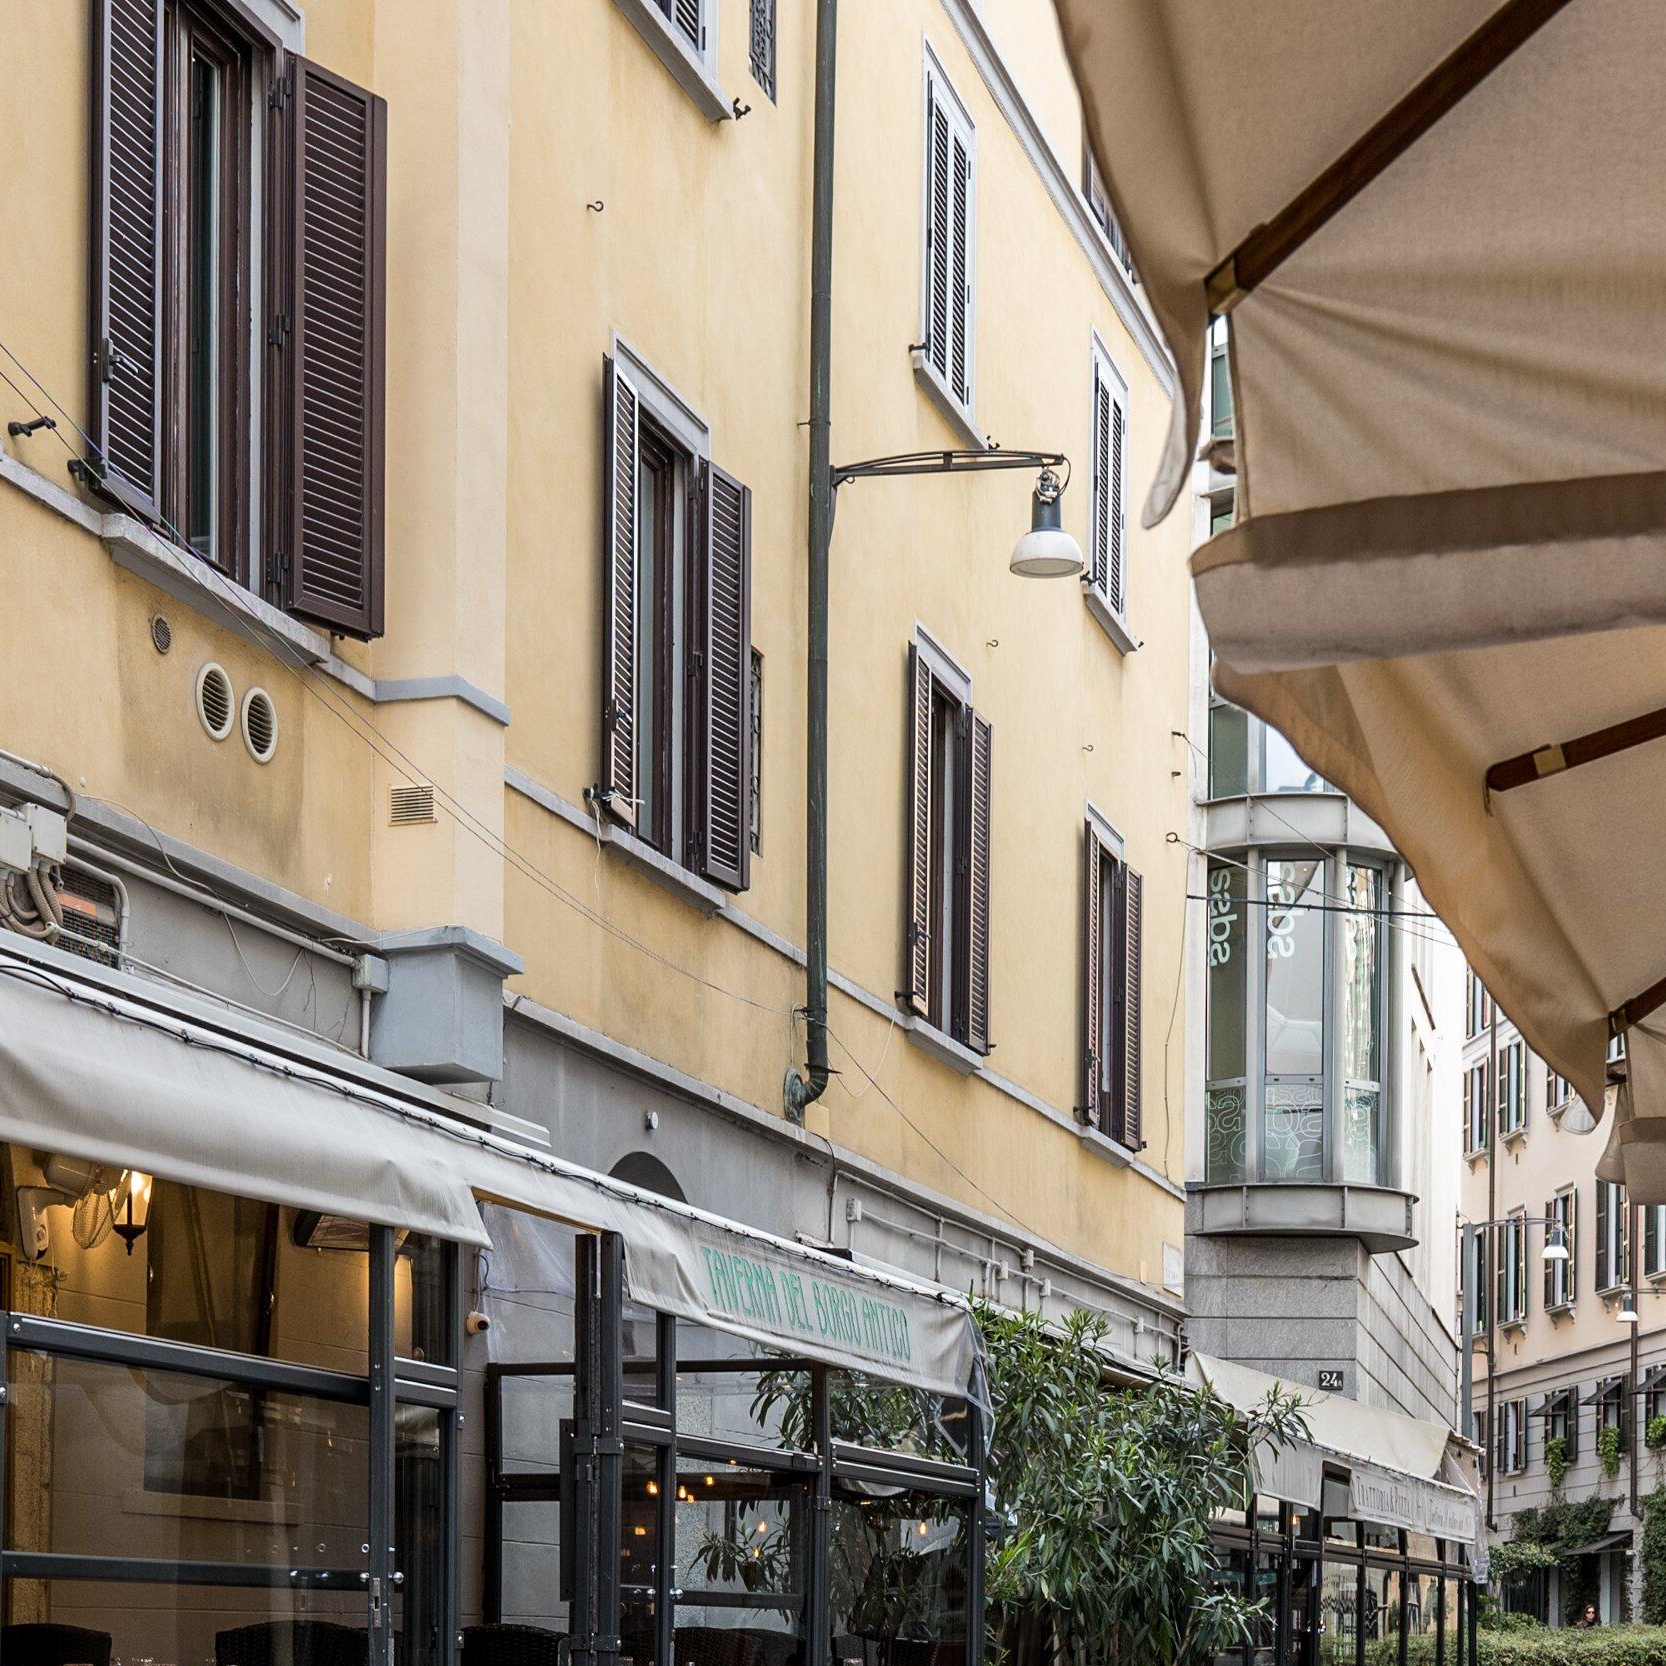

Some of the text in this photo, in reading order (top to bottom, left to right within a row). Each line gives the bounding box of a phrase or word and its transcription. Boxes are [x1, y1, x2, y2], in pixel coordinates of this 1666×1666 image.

[702, 1246, 912, 1362] TAVERNA DEL BORGO ANTICO
